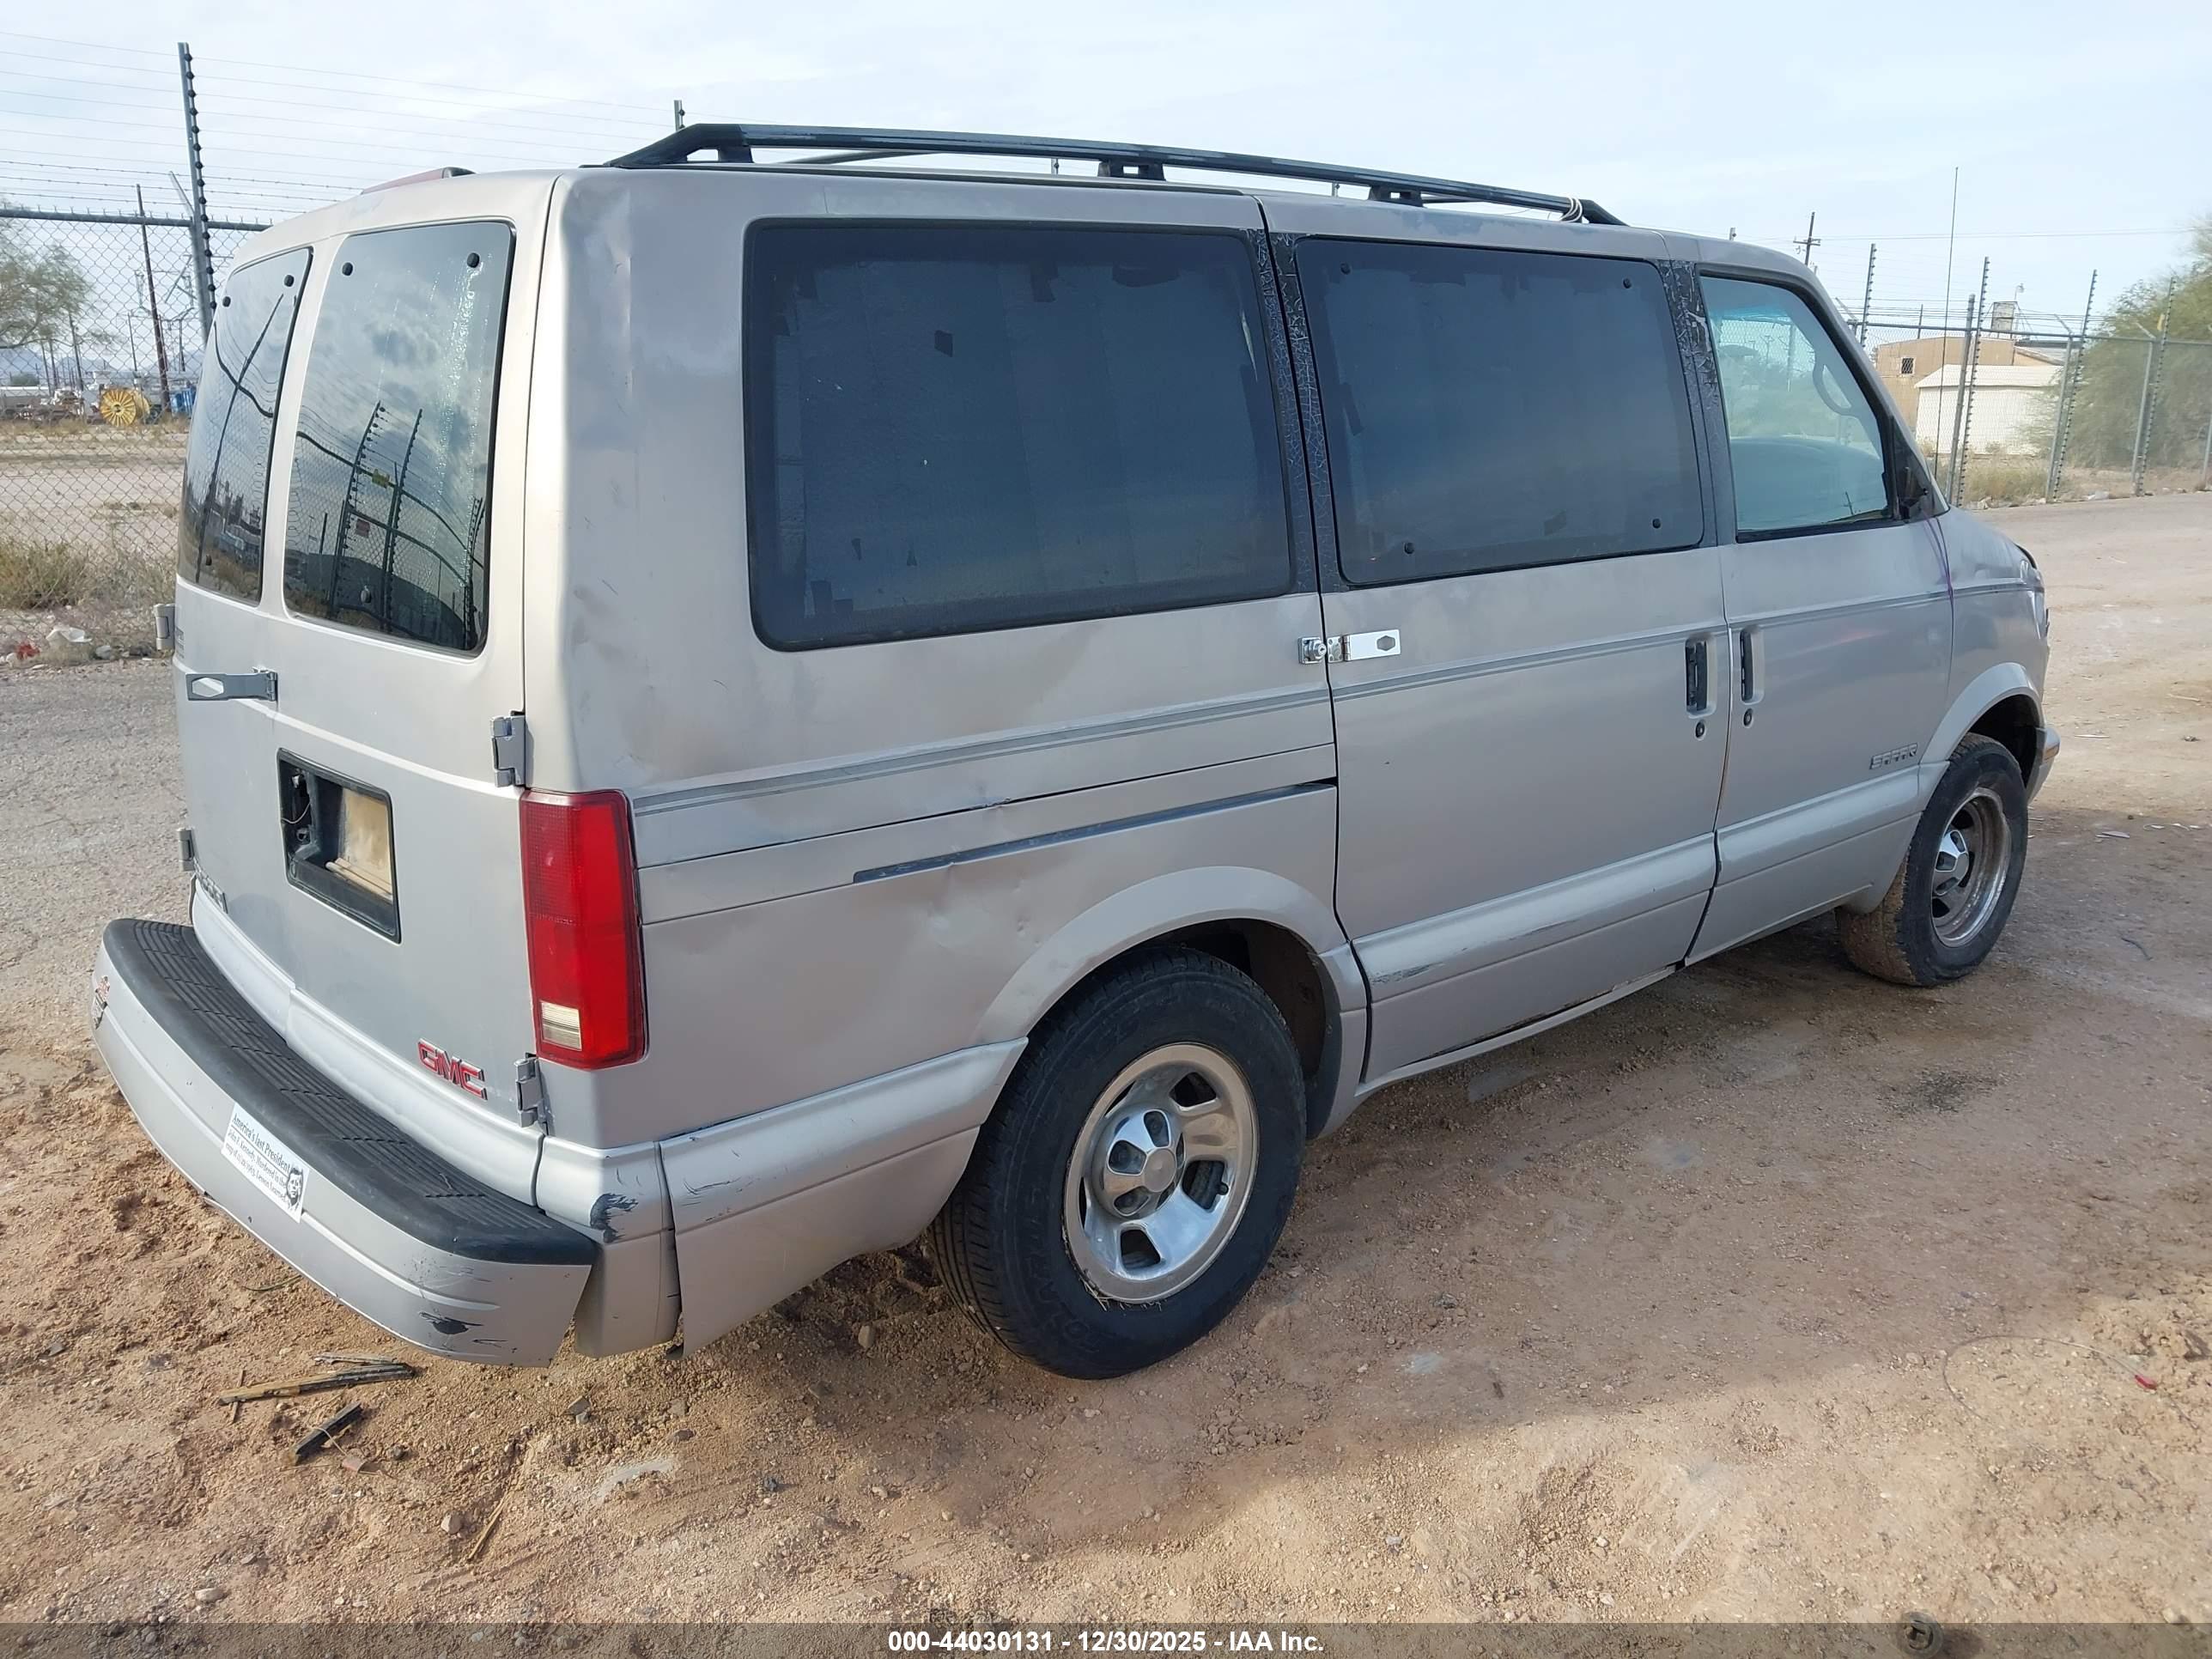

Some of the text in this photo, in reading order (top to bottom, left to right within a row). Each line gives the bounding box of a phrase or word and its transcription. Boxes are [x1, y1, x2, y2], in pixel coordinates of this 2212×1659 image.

[417, 1038, 488, 1101] GMC
[232, 1113, 291, 1174] America's last President
